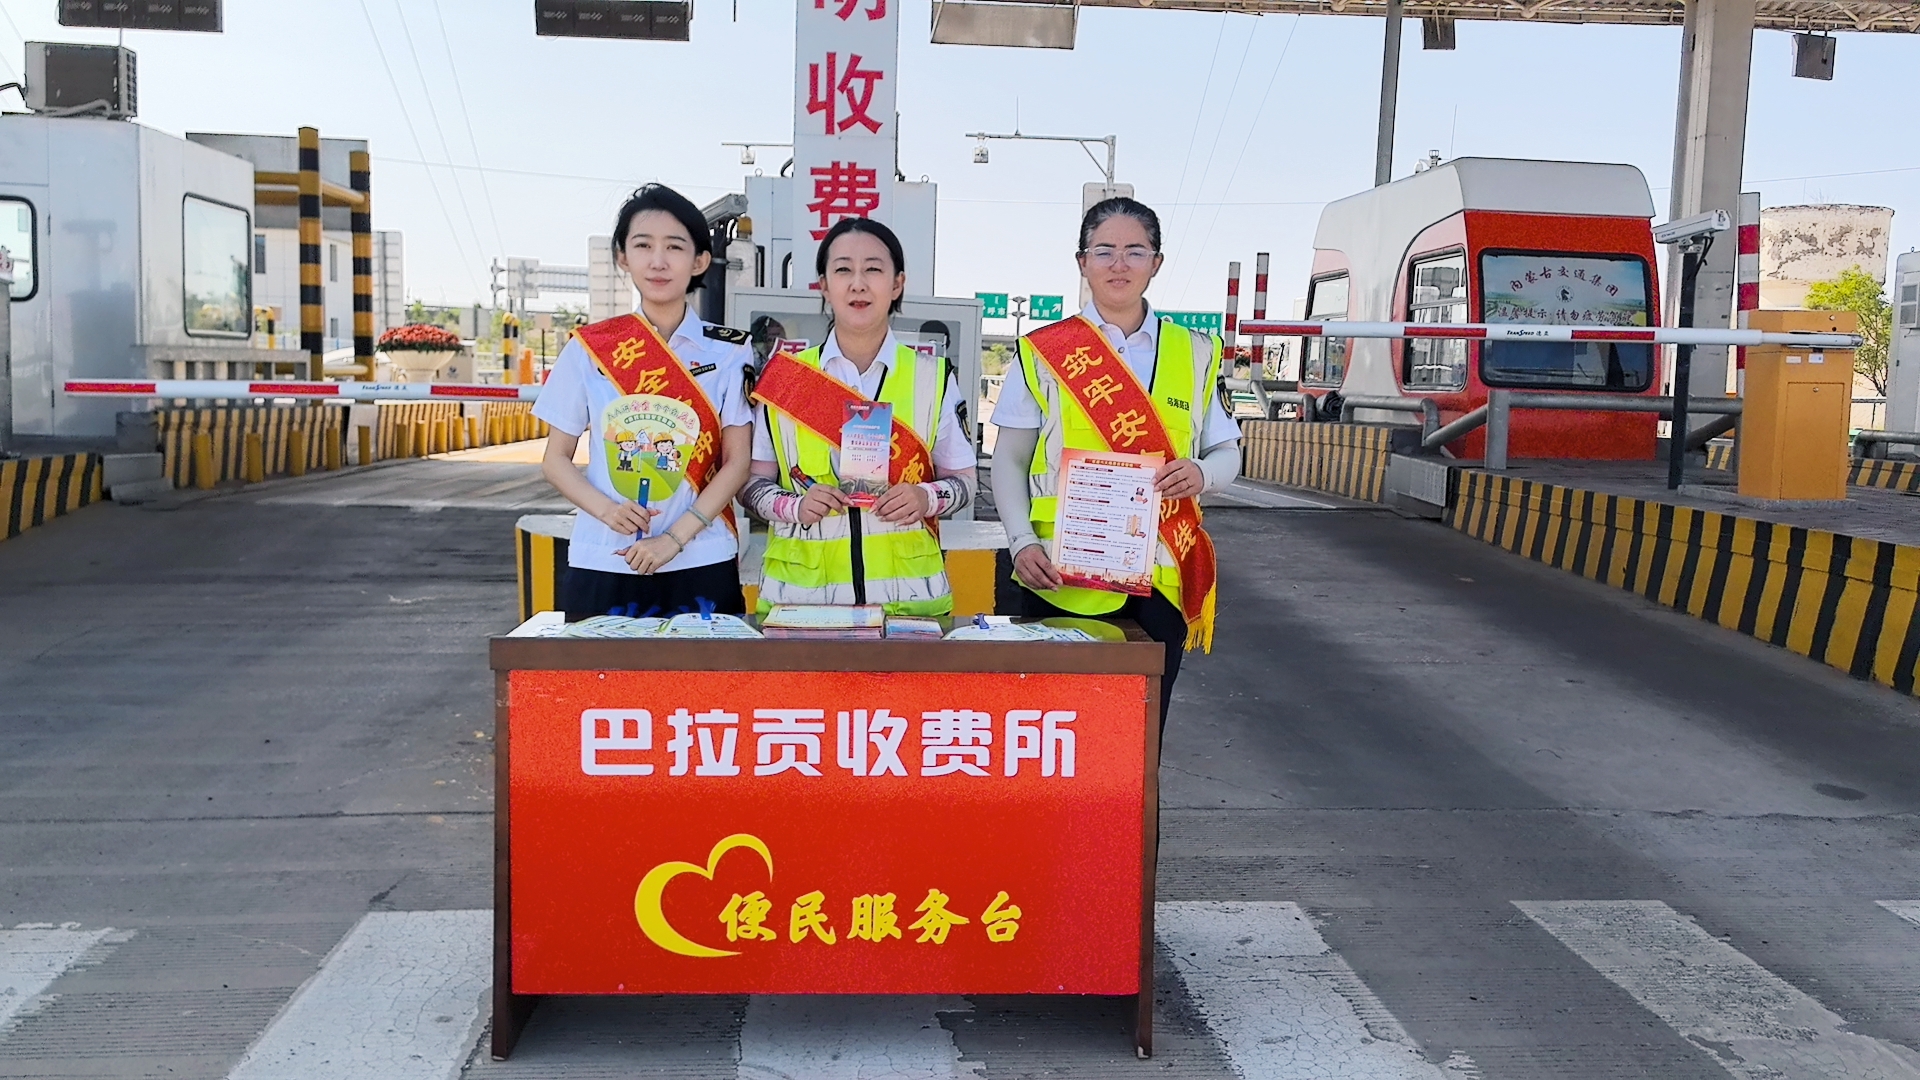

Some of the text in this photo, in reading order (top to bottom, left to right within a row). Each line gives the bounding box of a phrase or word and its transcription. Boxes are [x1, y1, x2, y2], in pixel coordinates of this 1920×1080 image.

[1509, 266, 1619, 297] 内蒙古交通集团
[580, 708, 1077, 778] 巴拉贡收费所
[719, 888, 1023, 945] 便民服务台
